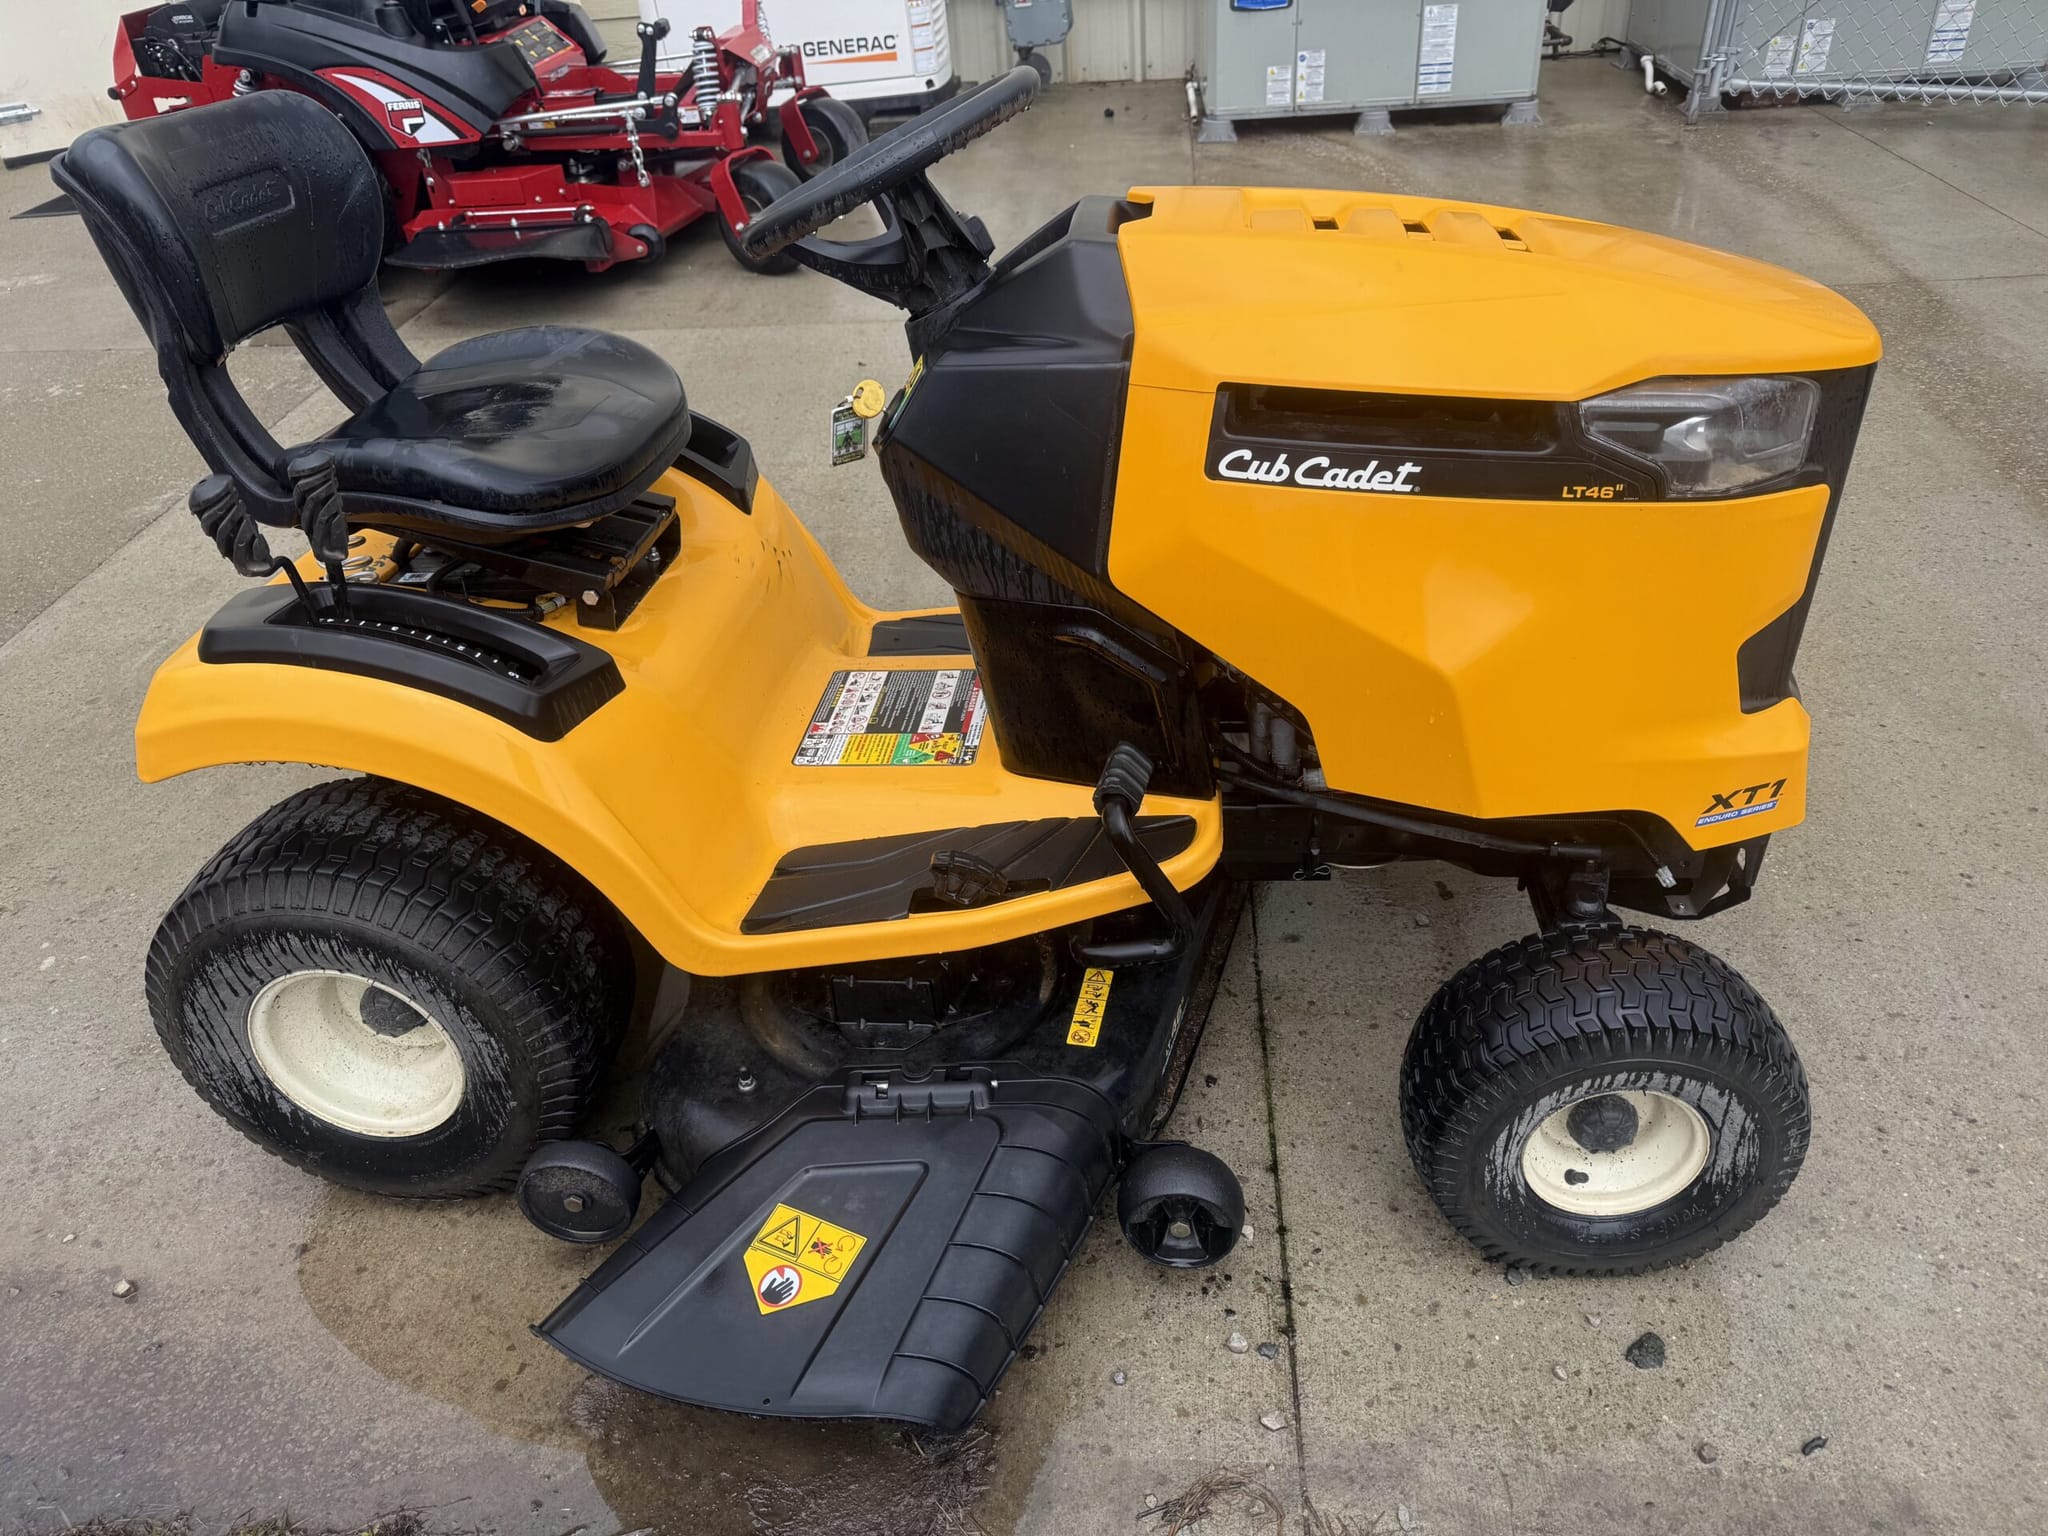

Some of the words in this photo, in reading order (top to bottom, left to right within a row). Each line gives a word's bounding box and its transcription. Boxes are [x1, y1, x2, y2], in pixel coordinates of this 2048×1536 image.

[803, 34, 896, 57] GENERAC
[387, 100, 421, 111] FERRIS
[1218, 449, 1290, 482] Cub
[1294, 456, 1422, 492] Cadet
[1561, 483, 1624, 499] LT46"
[1701, 778, 1787, 814] XT1
[1697, 811, 1739, 825] ENDURO
[1740, 800, 1777, 815] SERIES
